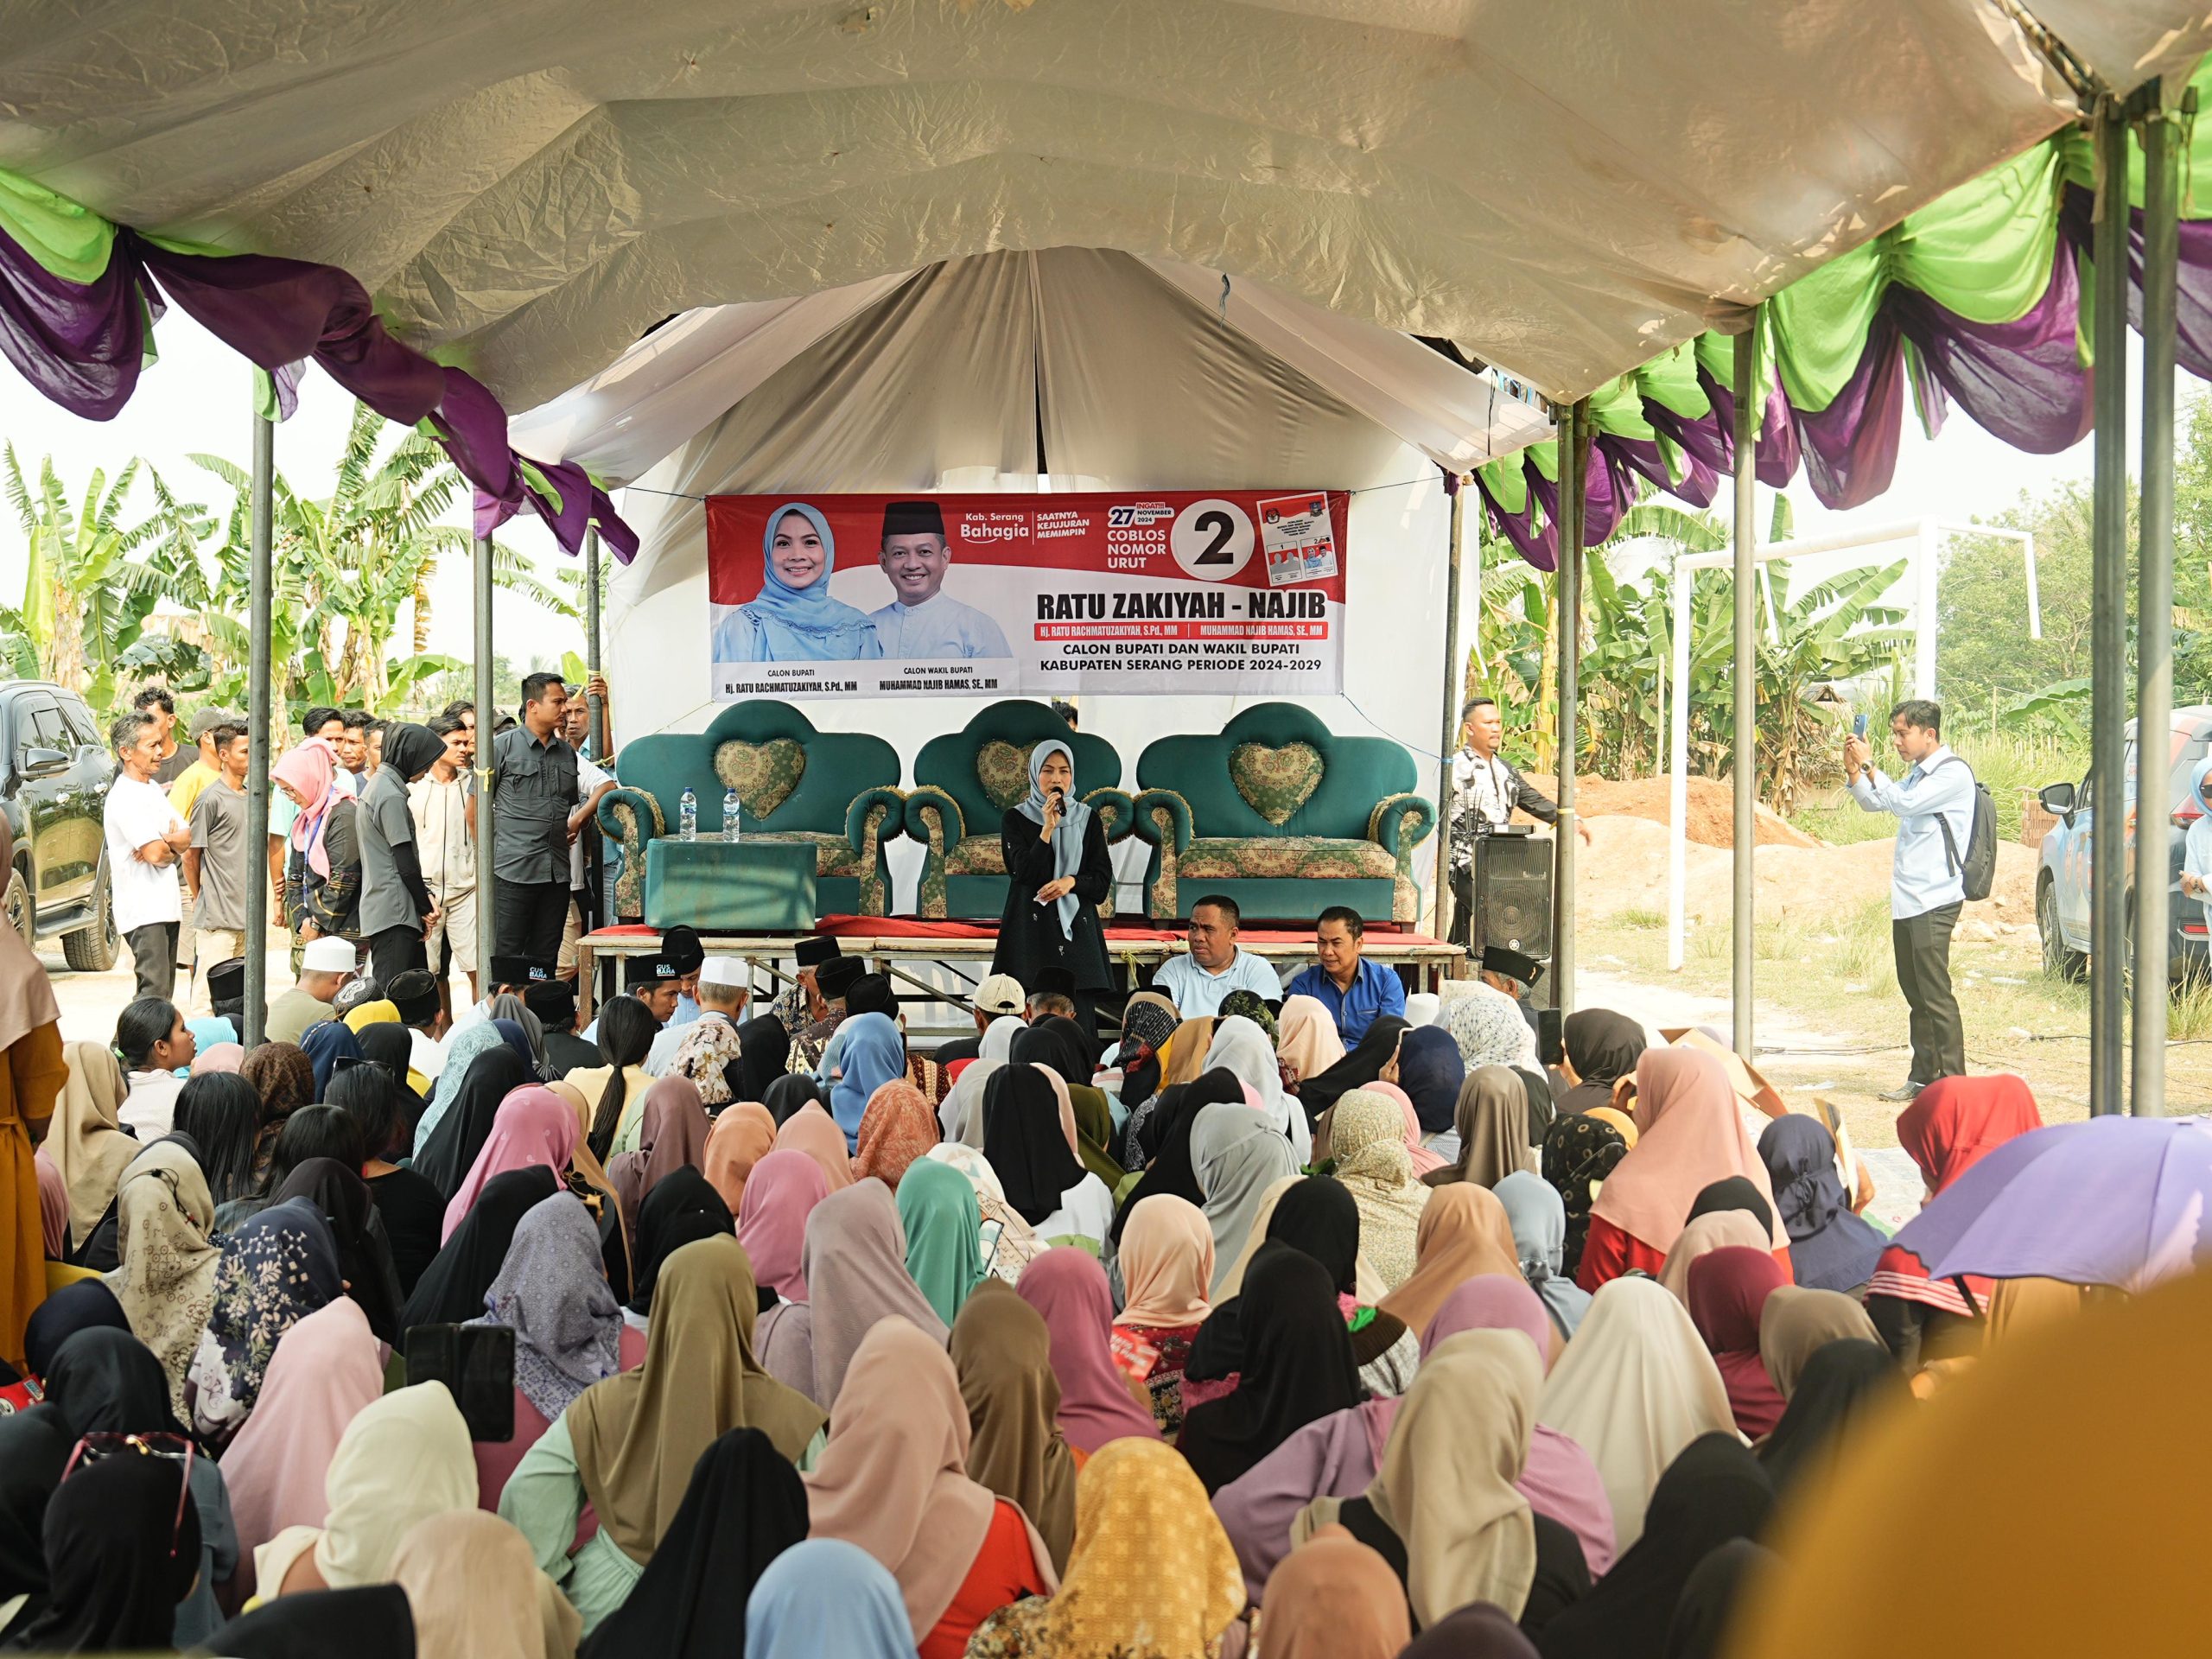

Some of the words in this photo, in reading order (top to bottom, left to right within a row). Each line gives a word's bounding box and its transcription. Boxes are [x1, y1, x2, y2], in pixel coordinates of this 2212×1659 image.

[990, 513, 1024, 522] Serang
[1037, 511, 1078, 521] SAATNYA
[1111, 509, 1135, 525] 27
[1037, 519, 1090, 530] KEJUJURAN
[960, 523, 1029, 540] Bahagia
[1037, 528, 1086, 539] MEMIMPIN
[1107, 530, 1166, 541] COBLOS
[1193, 511, 1235, 565] 2
[1107, 543, 1166, 555] NOMOR
[1107, 557, 1147, 569] URUT
[1037, 593, 1106, 620] RATU
[1112, 592, 1224, 619] ZAKIYAH
[1249, 592, 1325, 618] NAJIB
[1040, 626, 1050, 638] Hj.
[1051, 626, 1071, 636] RATU
[1071, 625, 1142, 637] RACHMATUZAKIYAH,
[1144, 625, 1163, 636] S.Pd.,
[1164, 625, 1177, 636] MM
[1200, 625, 1244, 636] MUHAMMAD
[1246, 625, 1266, 636] NAJIB
[1268, 625, 1295, 637] HAMAS,
[1309, 625, 1323, 636] MM
[1063, 644, 1110, 655] CALON
[1116, 644, 1163, 654] BUPATI
[1169, 644, 1199, 654] DAN
[1203, 644, 1247, 654] WAKIL
[1252, 644, 1299, 654] BUPATI
[1040, 660, 1122, 671] KABUPATEN
[1127, 659, 1183, 670] SERANG
[1188, 660, 1245, 670] PERIODE
[1249, 659, 1322, 670] 2024-2029
[725, 683, 734, 694] Hj.
[736, 683, 754, 693] RATU
[755, 682, 823, 693] RACHMATUZAKIYAH,
[845, 681, 858, 691] MM
[879, 680, 922, 690] MUHAMMAD
[923, 680, 943, 690] NAJIB
[944, 679, 971, 690] HAMAS,
[985, 679, 998, 689] MM
